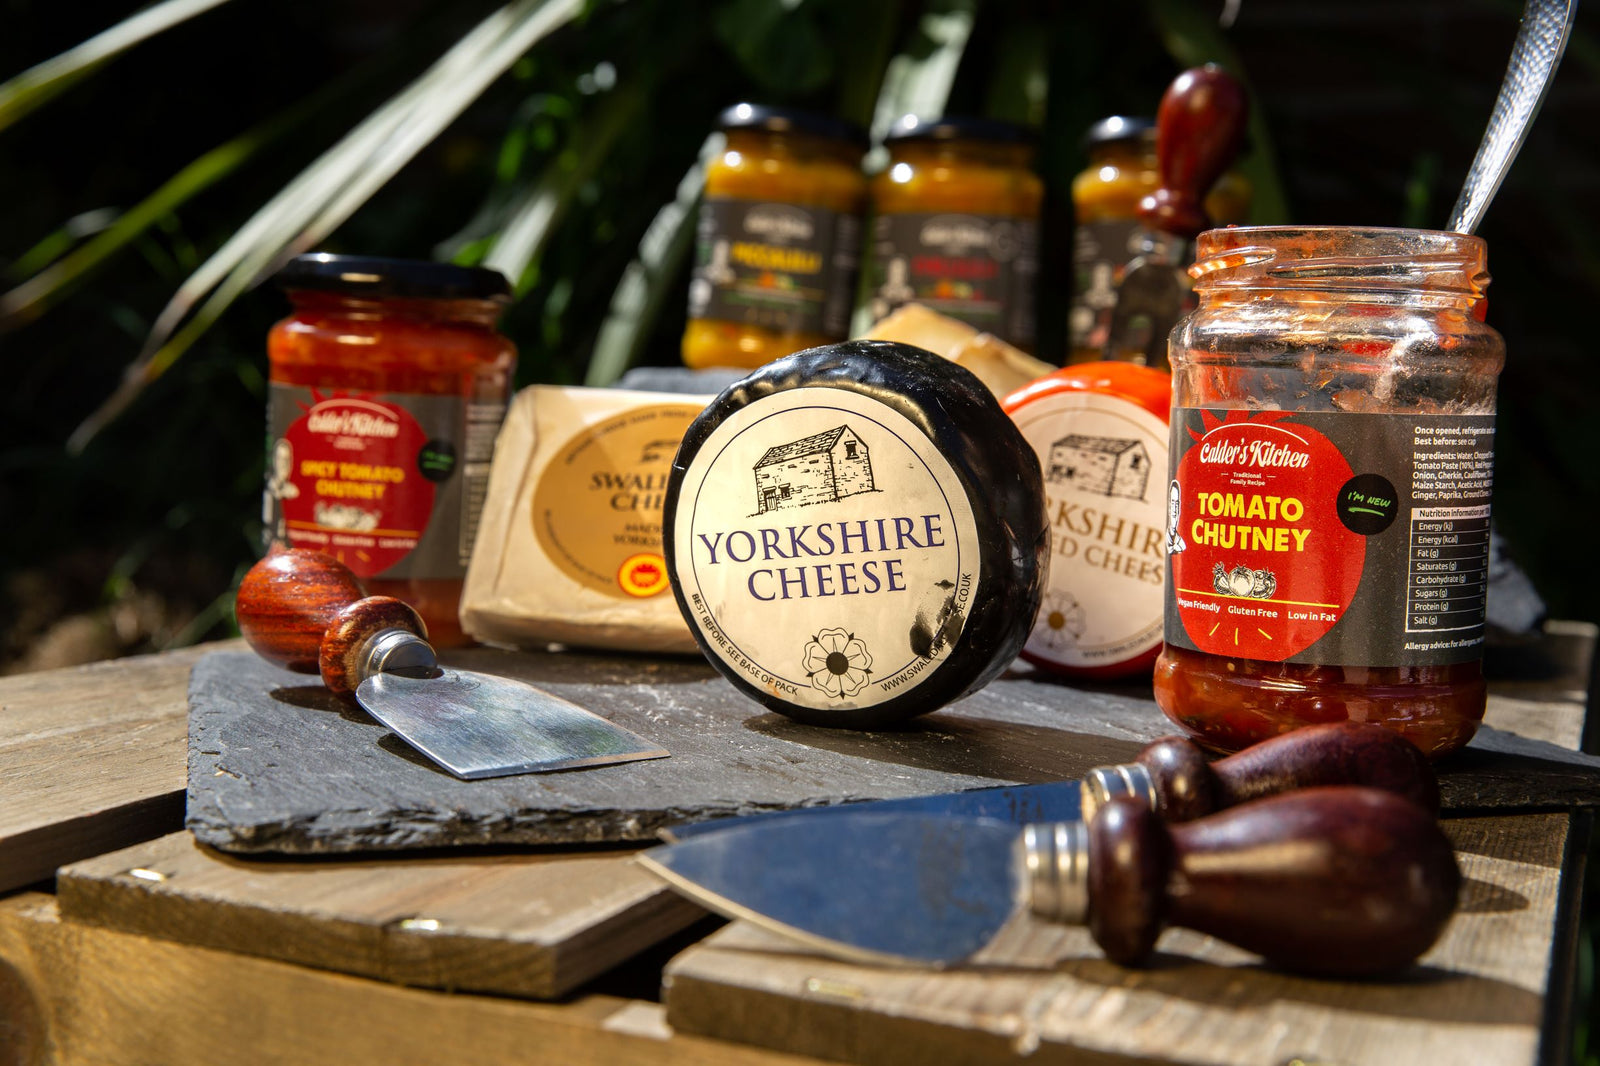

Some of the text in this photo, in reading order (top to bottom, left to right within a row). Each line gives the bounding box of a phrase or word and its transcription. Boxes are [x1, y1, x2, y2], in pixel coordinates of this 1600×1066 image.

[1414, 426, 1434, 435] Once
[1435, 427, 1461, 435] opened,
[1414, 437, 1431, 445] Best
[1433, 437, 1457, 445] before:
[1200, 437, 1310, 468] Calder's Kitchen
[1413, 452, 1457, 460] Ingredients:
[1457, 451, 1473, 460] Water,
[1413, 461, 1440, 470] Tomato
[1441, 461, 1458, 470] Paste
[338, 462, 406, 484] TOMATO
[1232, 471, 1261, 479] Traditional
[1412, 471, 1437, 480] Onion,
[1438, 471, 1463, 480] Gherkin,
[1230, 478, 1247, 486] Family
[1434, 481, 1457, 490] Starch,
[315, 478, 386, 500] CHUTNEY
[1348, 490, 1391, 507] I'M NEW
[1412, 491, 1438, 500] Ginger,
[1438, 491, 1462, 500] Paprika,
[1197, 491, 1304, 522] TOMATO
[1419, 510, 1450, 518] Nutrition
[1451, 509, 1479, 517] information
[1419, 522, 1442, 531] Energy
[697, 513, 945, 565] YORKSHIRE
[1191, 518, 1311, 552] CHUTNEY
[1418, 535, 1458, 545] Energy (kcal)
[1417, 549, 1439, 558] Fat (g)
[1416, 561, 1457, 571] Saturates (g)
[748, 559, 907, 601] CHEESE
[1416, 575, 1459, 584] Carbohydrate
[1415, 589, 1448, 598] Sugars (g)
[1177, 597, 1221, 614] Vegan Friendly
[1415, 602, 1449, 612] Protein (g)
[1227, 605, 1278, 618] Gluten Free
[1288, 611, 1336, 622] Low in Fat
[1414, 616, 1438, 625] Salt (g)
[691, 593, 799, 696] BEST BEFORE SEE BASE OF PACK
[1404, 642, 1430, 651] Allergy
[1430, 641, 1450, 650] advice:
